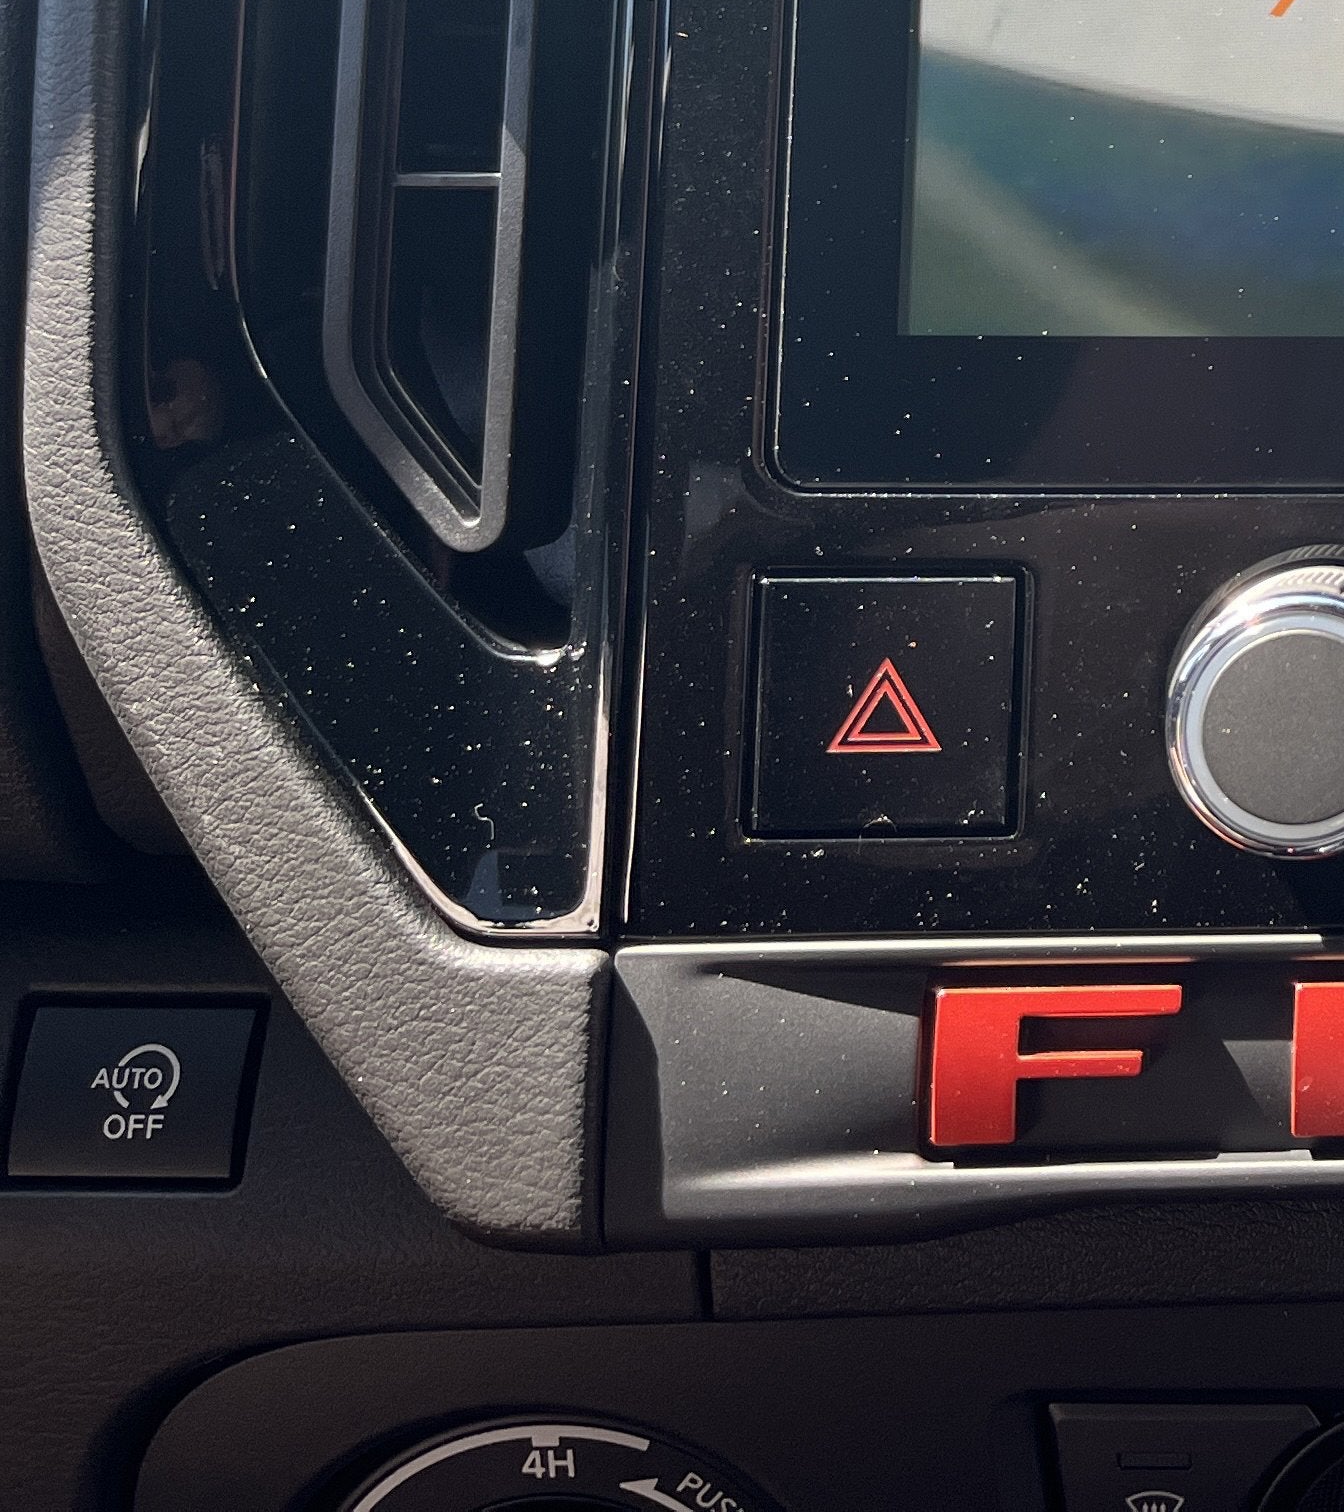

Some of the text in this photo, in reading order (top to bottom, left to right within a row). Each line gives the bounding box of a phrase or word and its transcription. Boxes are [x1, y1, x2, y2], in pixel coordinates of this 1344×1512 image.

[90, 1067, 163, 1090] AUTO
[102, 1113, 165, 1140] OFF
[521, 1449, 575, 1479] 4H
